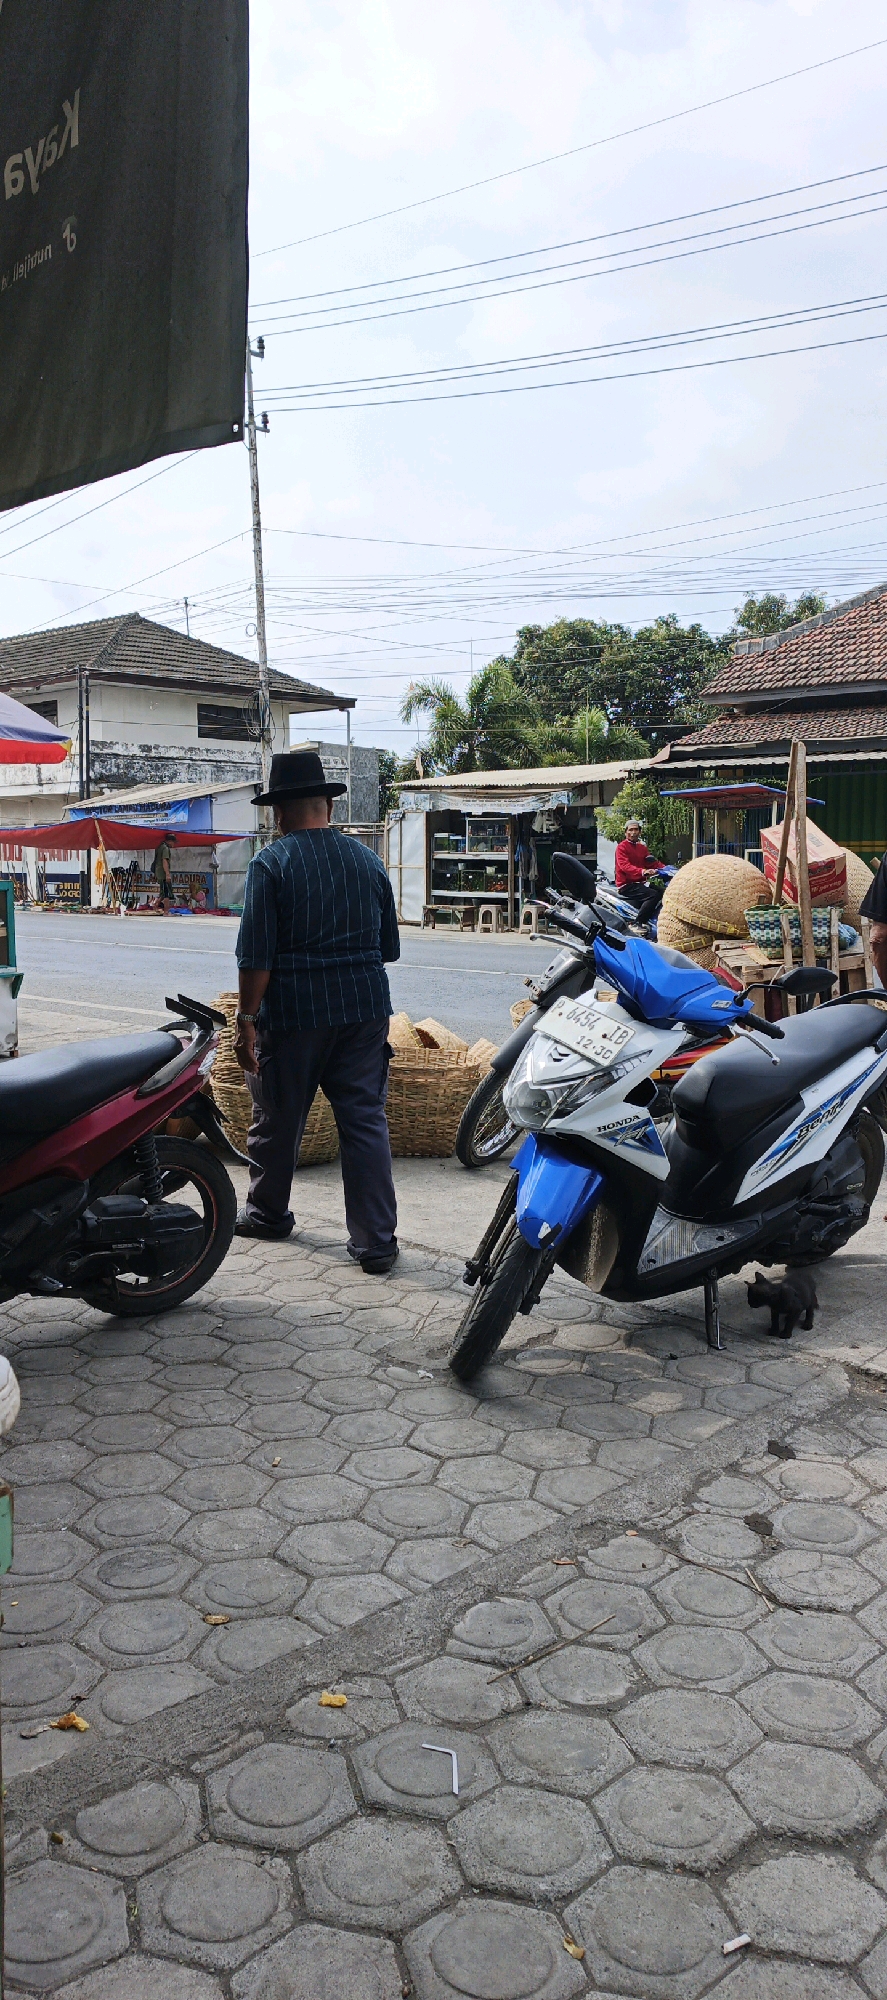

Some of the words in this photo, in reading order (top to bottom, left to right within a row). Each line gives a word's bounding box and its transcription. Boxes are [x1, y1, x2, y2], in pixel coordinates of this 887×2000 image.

[172, 873, 206, 884] MADURA
[551, 1000, 565, 1014] P
[566, 1007, 601, 1031] 6454
[606, 1026, 629, 1045] IB
[597, 1114, 641, 1133] HONDA
